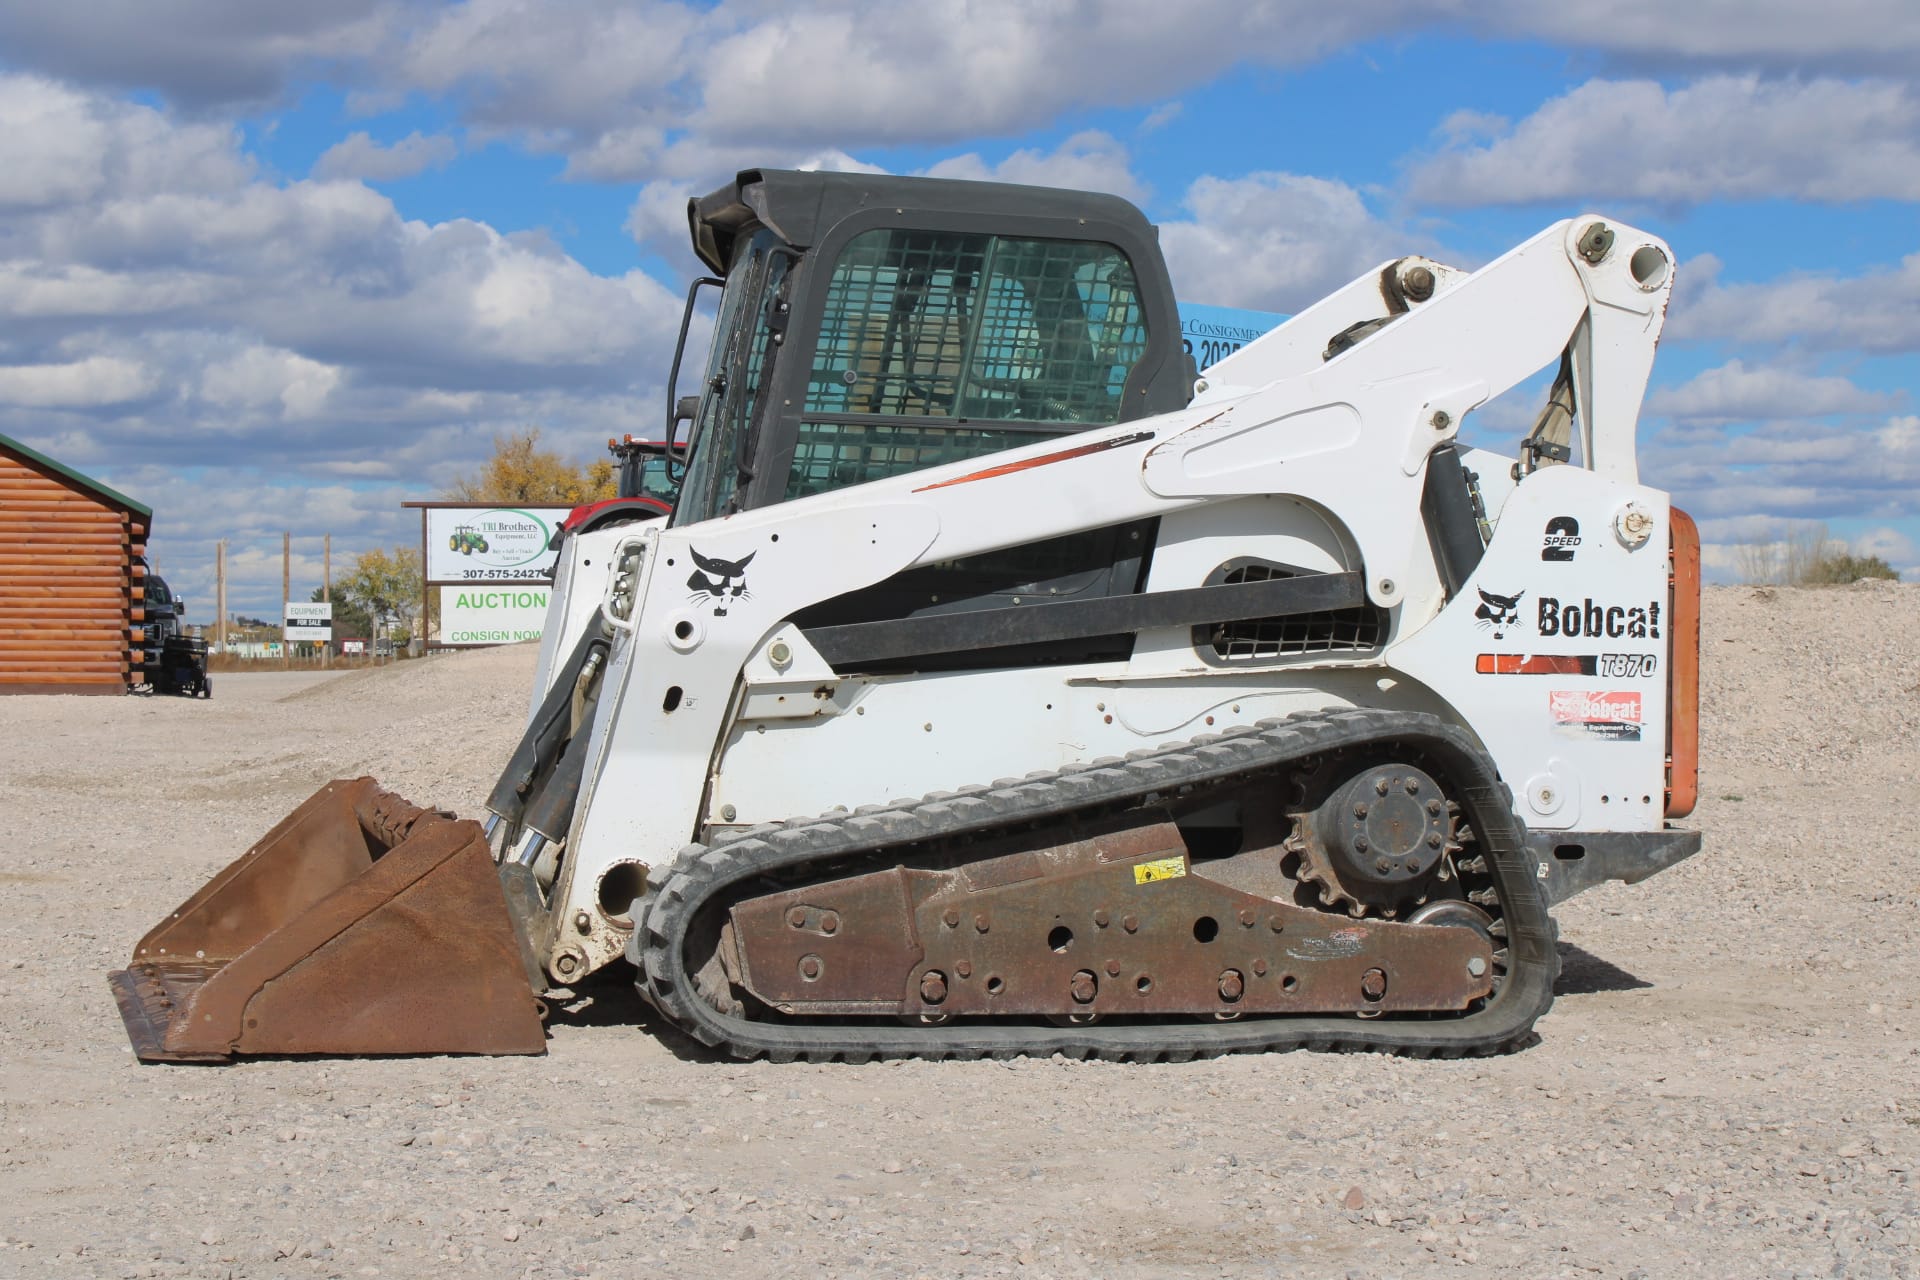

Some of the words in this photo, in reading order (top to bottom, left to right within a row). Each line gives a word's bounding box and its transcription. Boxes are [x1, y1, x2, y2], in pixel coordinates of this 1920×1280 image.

[1190, 318, 1265, 340] CONSIGNMEN
[481, 522, 496, 531] TRI
[498, 522, 537, 531] Brothers
[1541, 516, 1580, 561] 2
[1543, 536, 1581, 546] SPEED
[463, 569, 541, 579] 307-575-2427
[455, 593, 546, 609] AUCTION
[291, 607, 327, 616] EQUIPMENT
[1538, 597, 1660, 639] Bobcat
[451, 631, 509, 641] CONSIGN
[513, 631, 543, 641] NOW
[1601, 653, 1657, 678] T870
[1580, 699, 1637, 719] Bobcat
